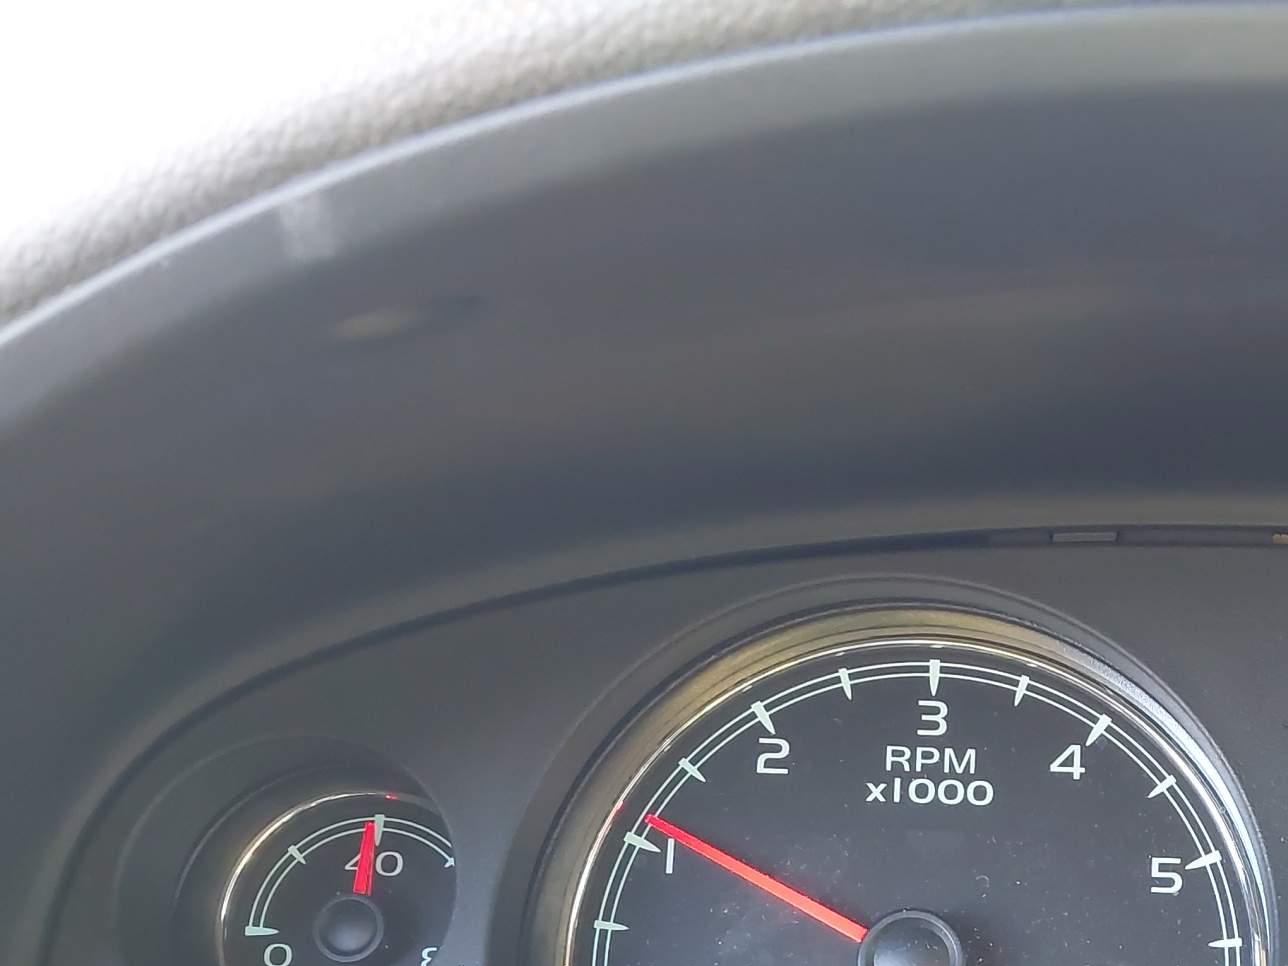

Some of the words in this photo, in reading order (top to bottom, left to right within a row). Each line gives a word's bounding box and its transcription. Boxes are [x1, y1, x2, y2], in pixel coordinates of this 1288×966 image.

[916, 700, 948, 736] 3
[756, 737, 790, 775] 2
[885, 745, 976, 774] RPM
[1049, 744, 1086, 780] 4
[865, 777, 994, 806] x1000
[666, 837, 676, 874] 1
[1150, 857, 1183, 896] 5
